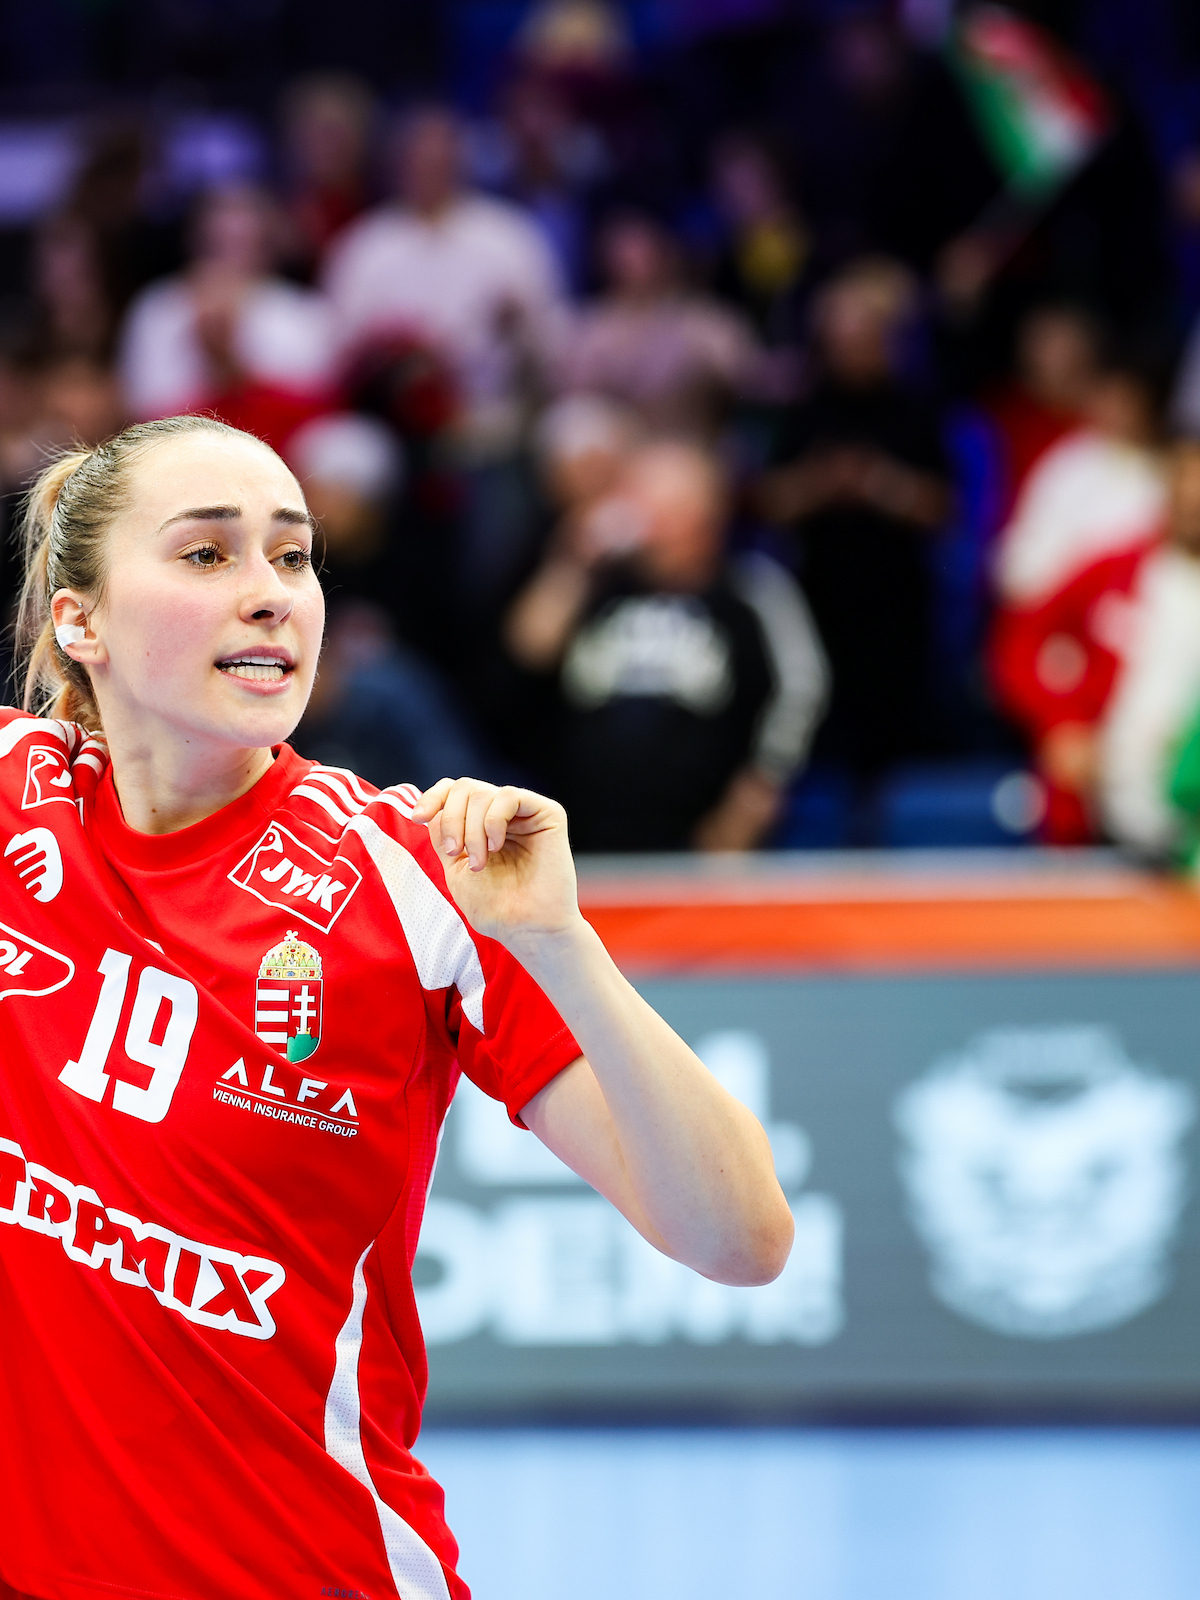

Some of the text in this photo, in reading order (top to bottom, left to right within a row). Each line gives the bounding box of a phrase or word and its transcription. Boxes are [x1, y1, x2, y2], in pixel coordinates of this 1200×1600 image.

[57, 947, 199, 1123] 19
[212, 1087, 358, 1138] VIENNA INSURANCE GROUP
[221, 1056, 358, 1117] ALFA
